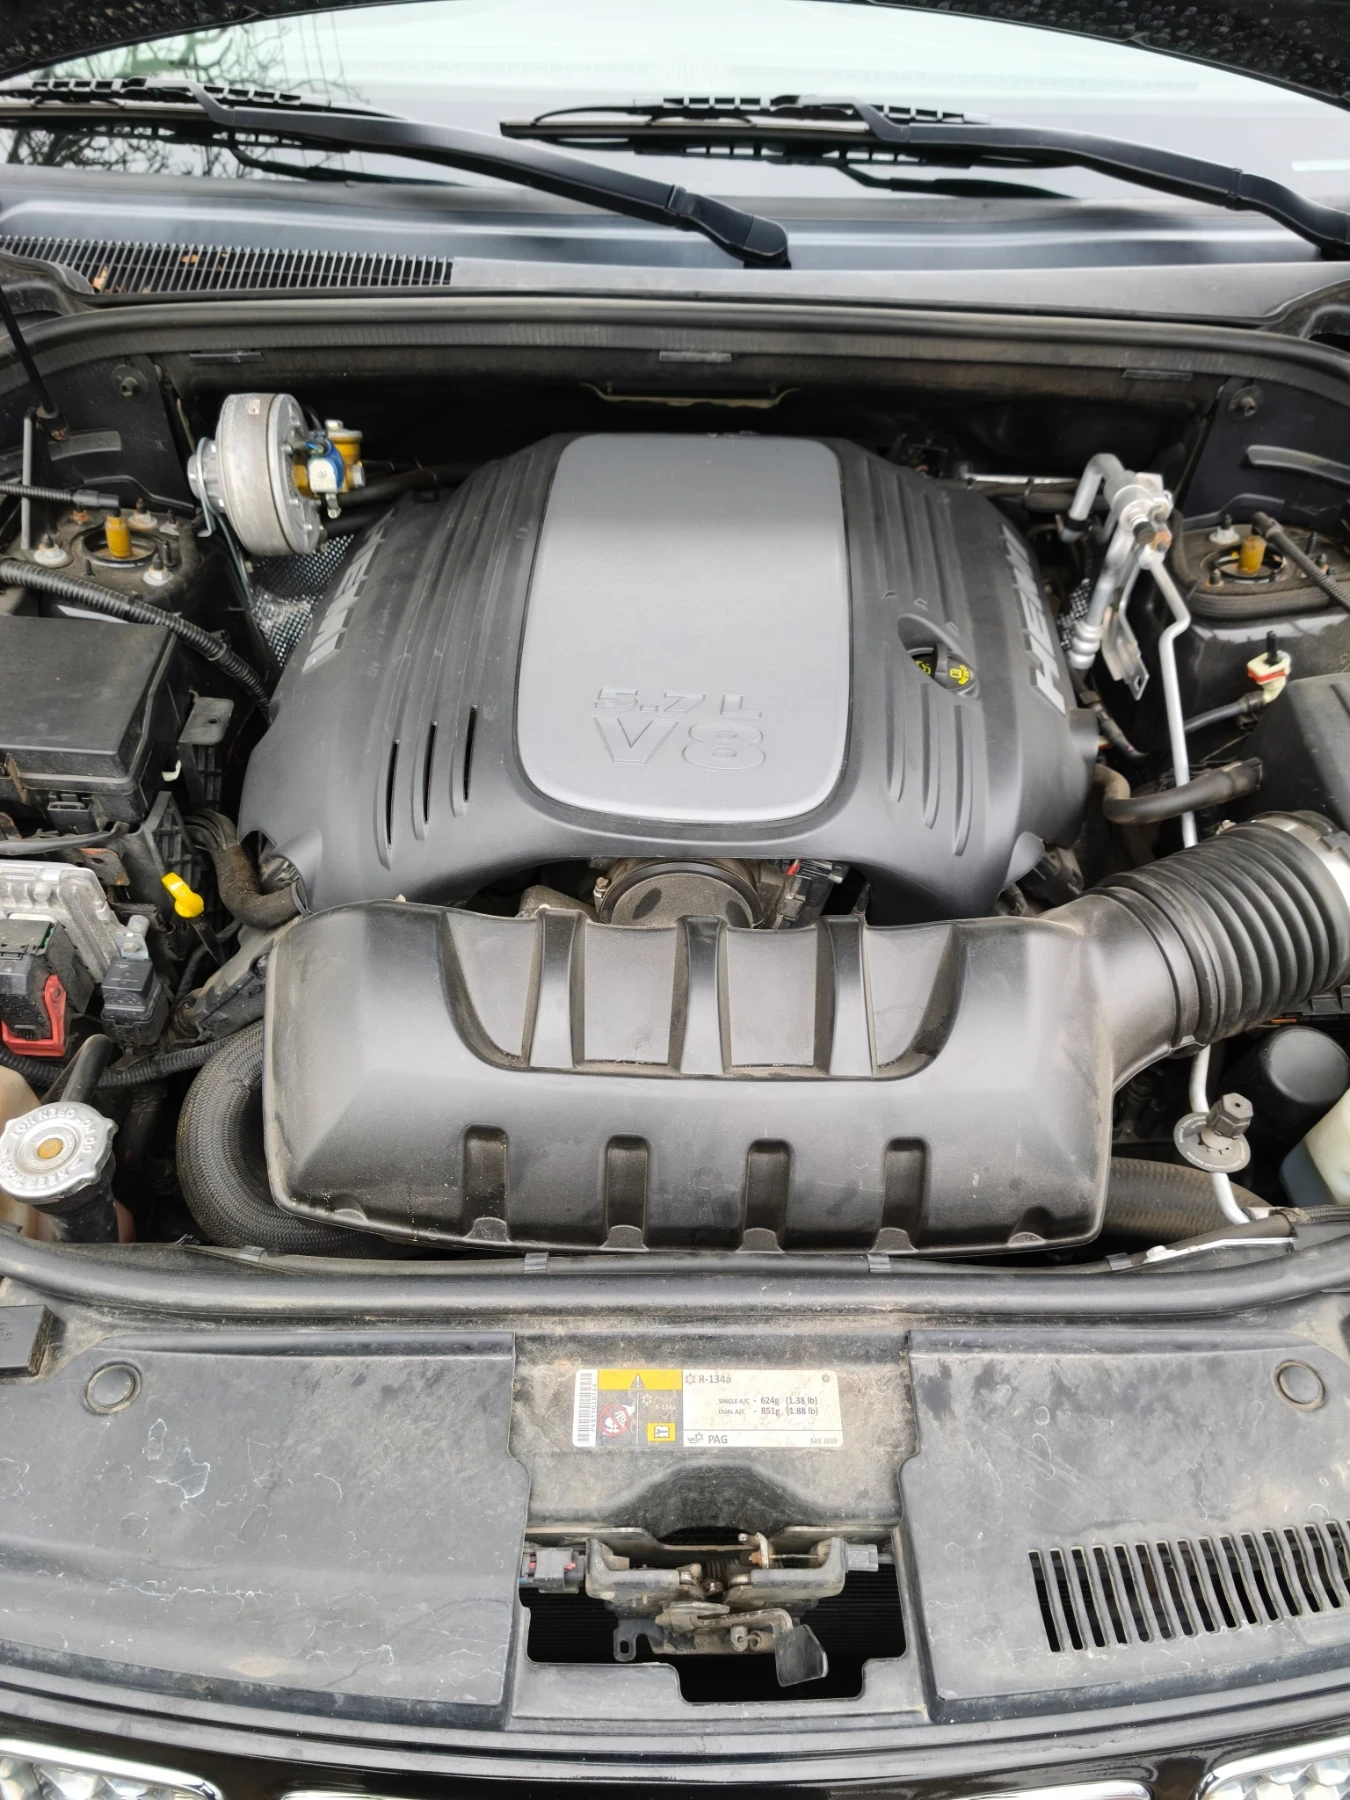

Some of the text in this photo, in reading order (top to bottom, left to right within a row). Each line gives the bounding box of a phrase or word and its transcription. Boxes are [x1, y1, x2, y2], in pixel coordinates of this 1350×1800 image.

[1002, 523, 1066, 715] HEMI
[593, 715, 767, 772] V8
[39, 1107, 76, 1121] OPEN
[9, 1115, 37, 1140] HOT
[76, 1113, 97, 1134] NOT
[82, 1136, 96, 1153] DO
[25, 1168, 70, 1190] KEEP
[698, 1374, 732, 1384] R-134a
[760, 1396, 780, 1406] 624g
[785, 1396, 806, 1406] (1.38
[807, 1396, 818, 1406] lb)
[761, 1407, 781, 1417] 851g
[786, 1407, 807, 1417] (1.88
[808, 1407, 819, 1417] lb)
[708, 1434, 728, 1444] PAG
[810, 1437, 822, 1445] SAE
